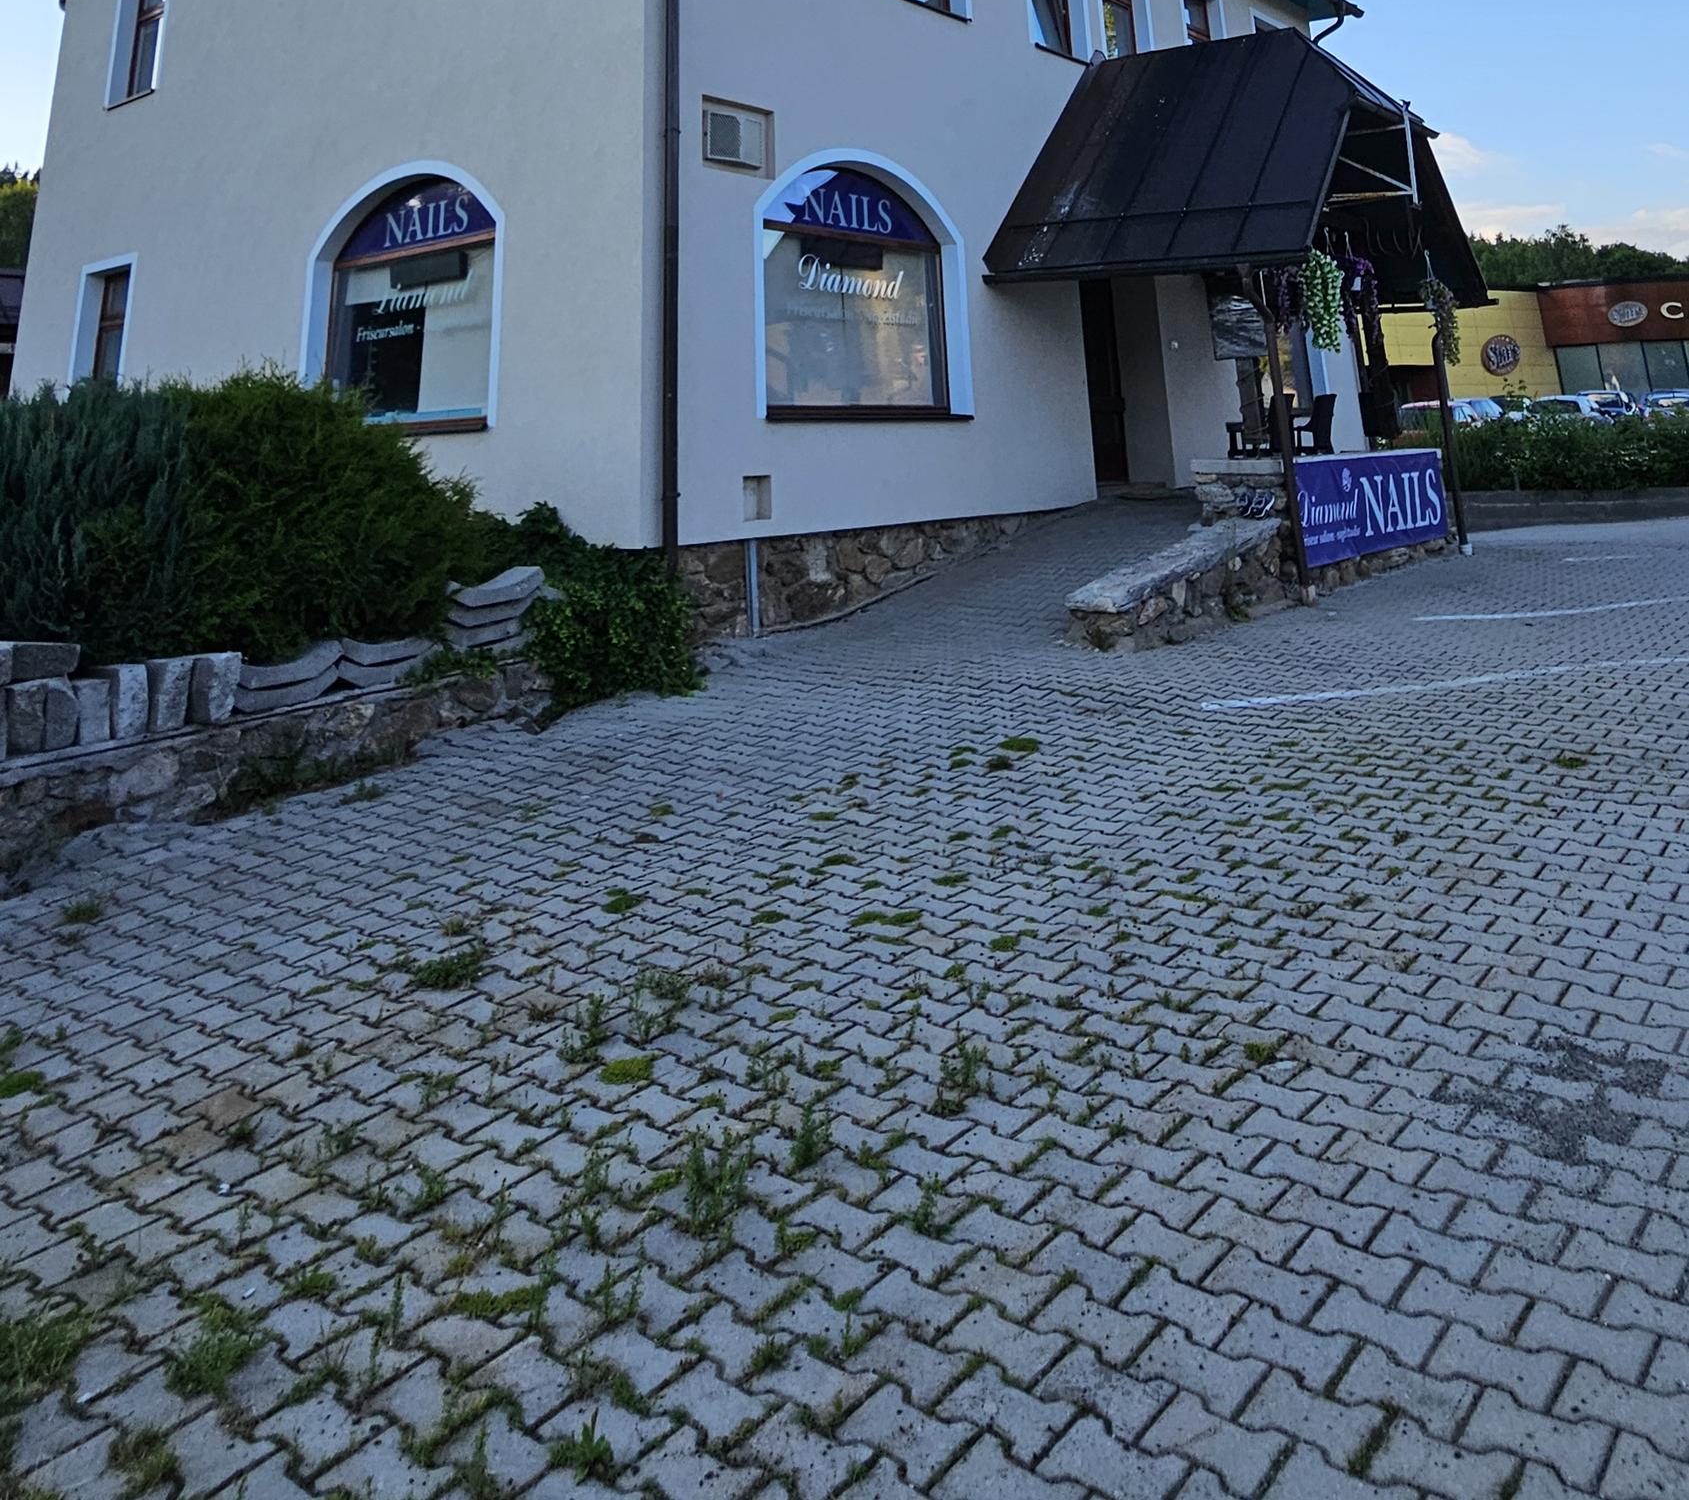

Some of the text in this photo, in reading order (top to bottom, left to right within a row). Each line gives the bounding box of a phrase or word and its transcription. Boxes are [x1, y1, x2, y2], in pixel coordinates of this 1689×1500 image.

[383, 195, 470, 248] NAILS
[802, 188, 892, 234] NAILS
[797, 253, 905, 300] Diamond
[1297, 488, 1359, 528] Diamond
[1359, 468, 1441, 537] NAILS
